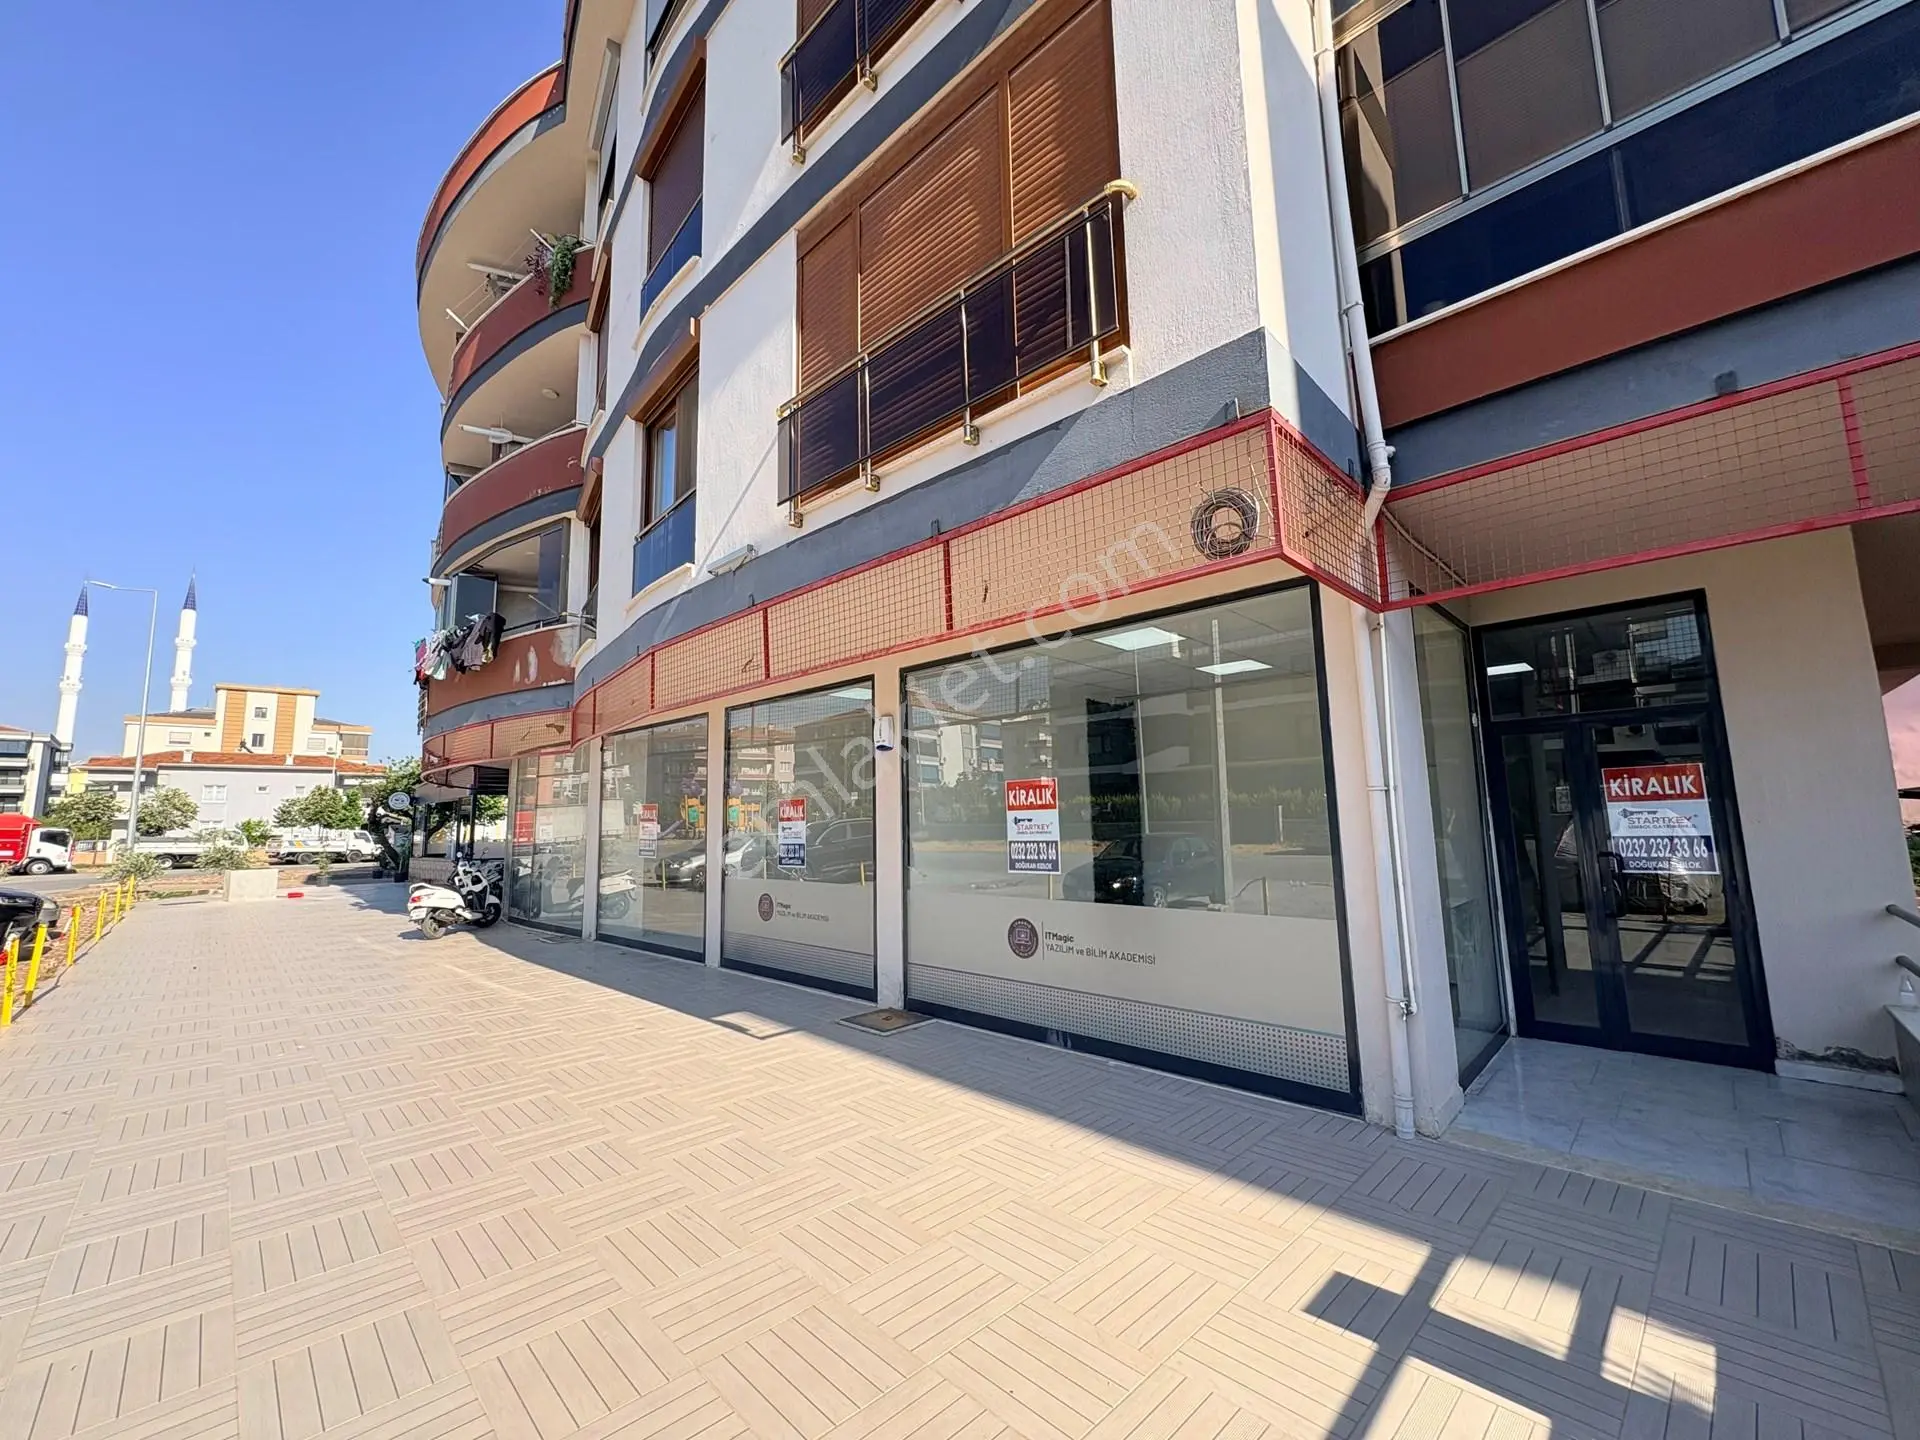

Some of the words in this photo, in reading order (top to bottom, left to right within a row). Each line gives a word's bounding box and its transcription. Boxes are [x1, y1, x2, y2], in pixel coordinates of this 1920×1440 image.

[1609, 774, 1698, 797] KİRALIK
[1008, 786, 1054, 806] KİRALIK
[1016, 823, 1050, 831] STARTKEY
[1628, 815, 1693, 825] STARTKEY
[1011, 842, 1025, 859] 0232
[1026, 842, 1038, 859] 232
[1039, 842, 1047, 860] 33
[1618, 837, 1648, 858] 0232
[1649, 837, 1672, 858] 232
[1674, 837, 1690, 858] 33
[1693, 837, 1709, 858] 66
[1045, 931, 1074, 943] ITMagic
[1045, 943, 1074, 955] YAZILIM
[1075, 948, 1085, 956] ve
[1086, 946, 1108, 958] BİLİM
[1109, 950, 1156, 965] AKADEMİSİ
